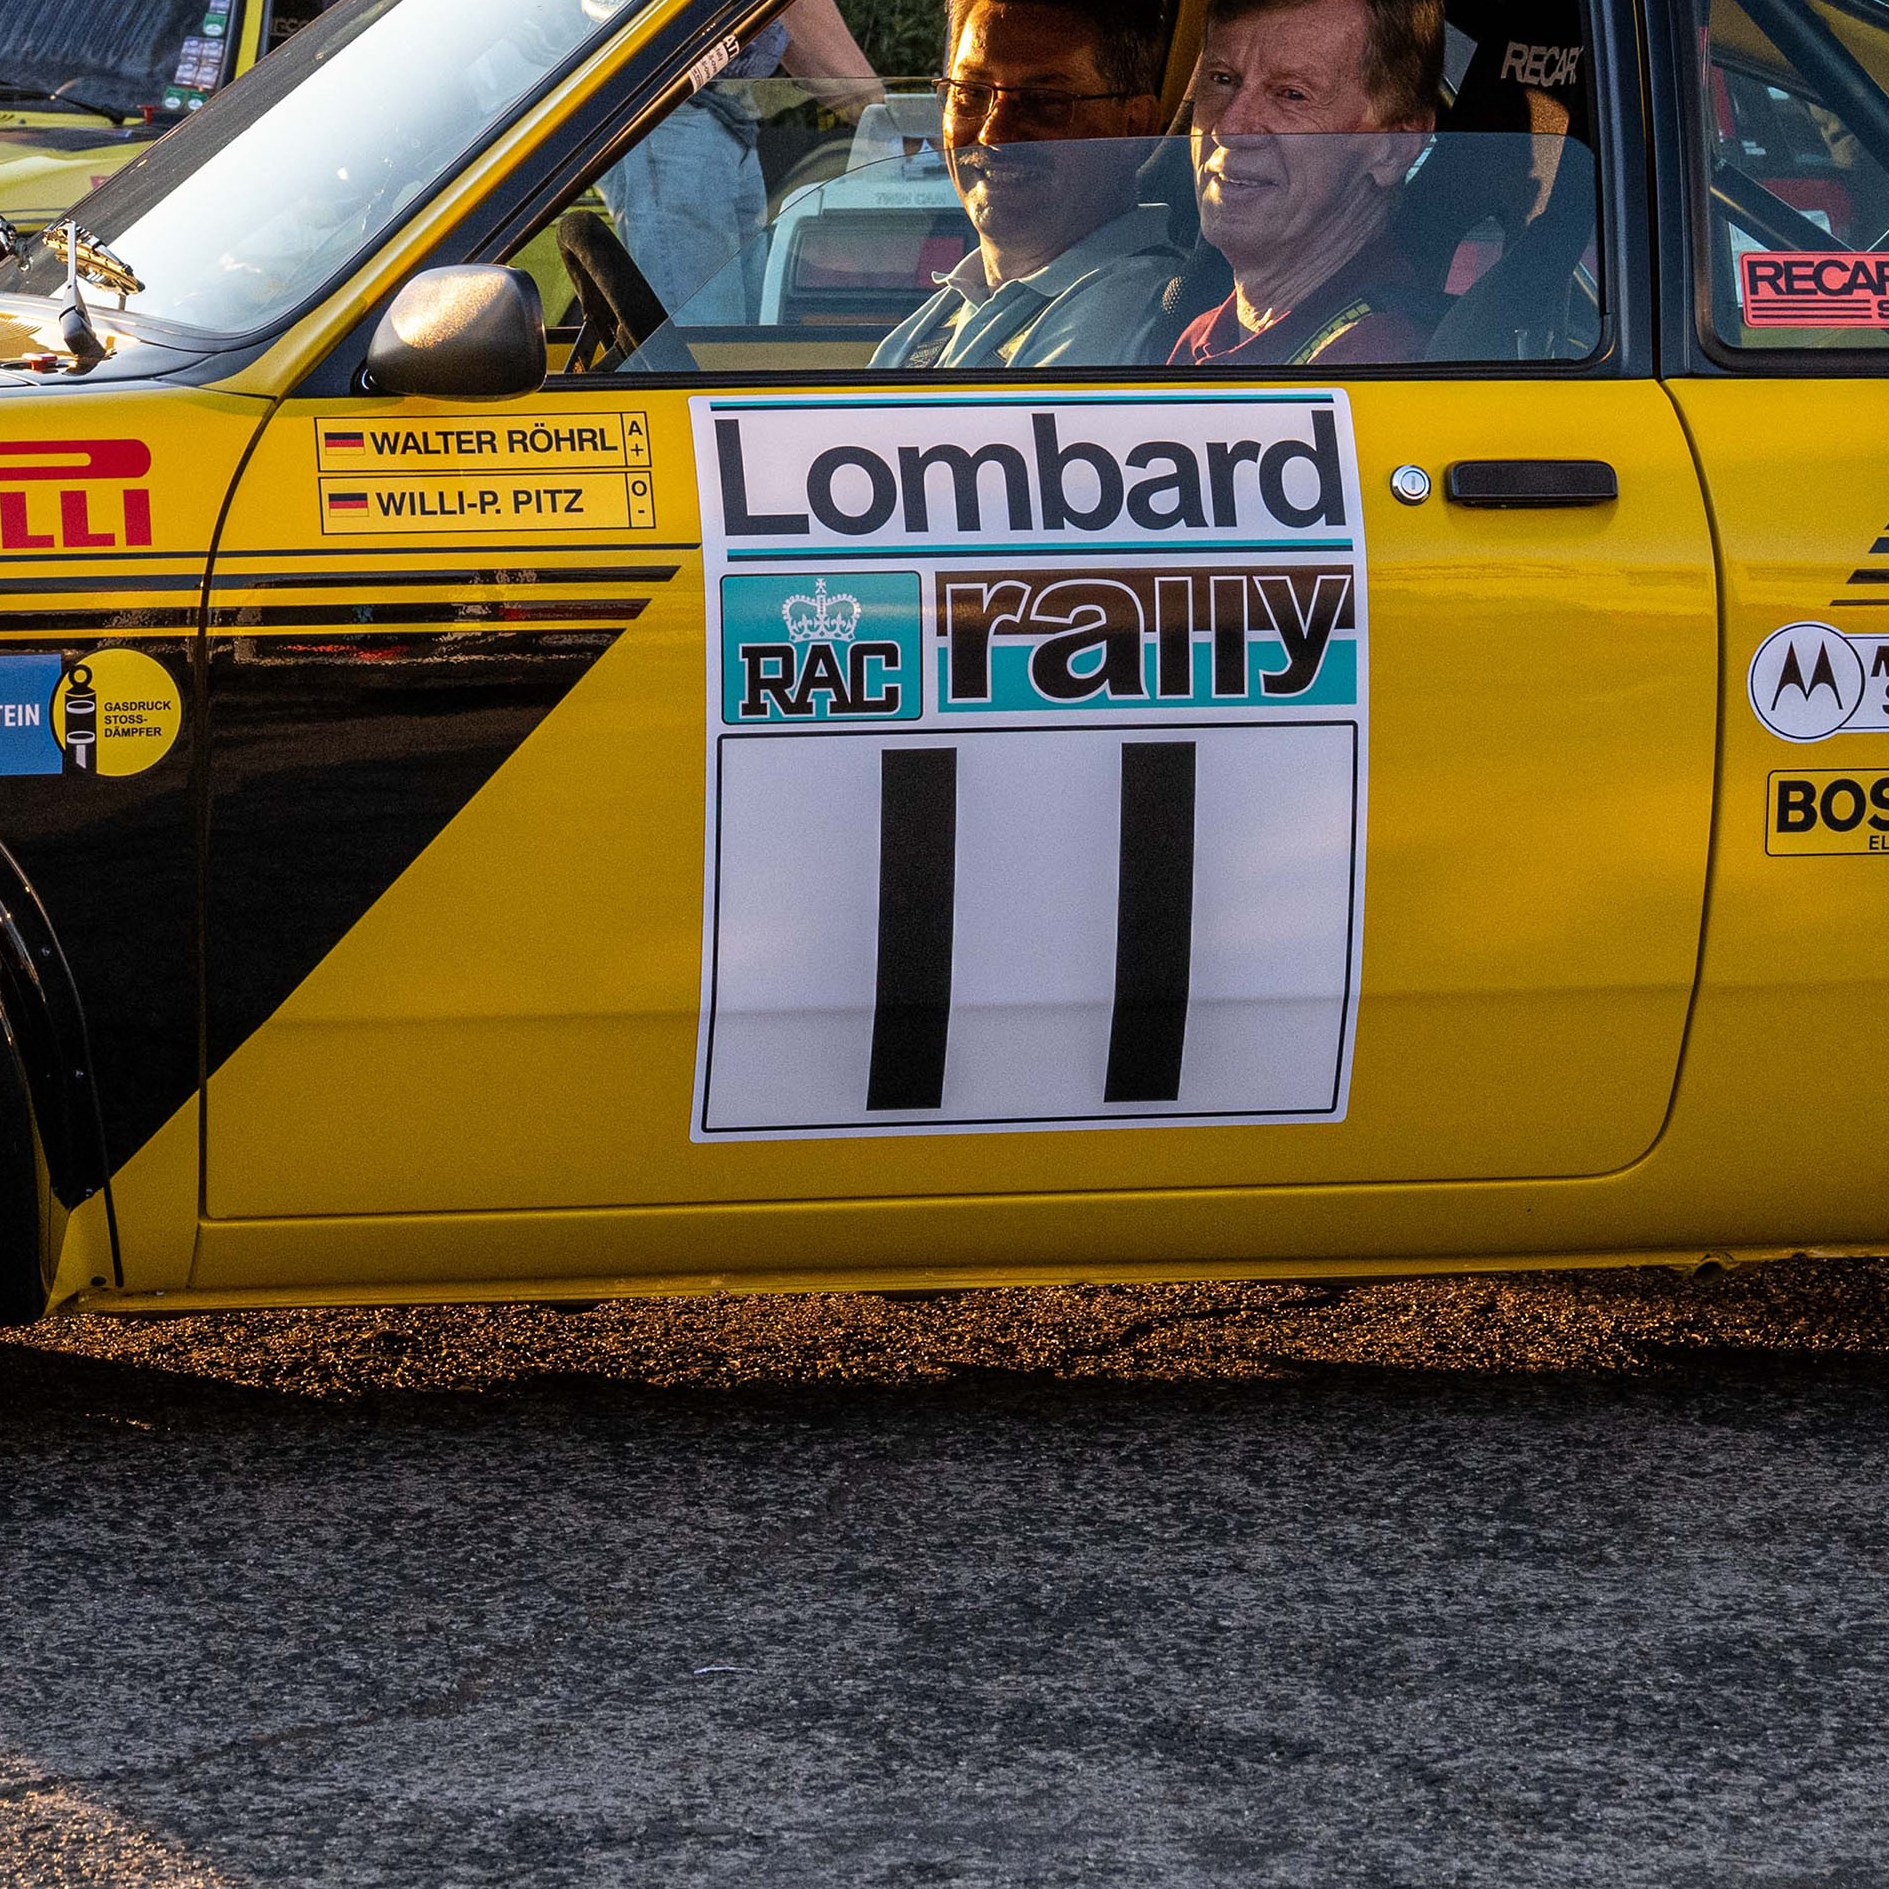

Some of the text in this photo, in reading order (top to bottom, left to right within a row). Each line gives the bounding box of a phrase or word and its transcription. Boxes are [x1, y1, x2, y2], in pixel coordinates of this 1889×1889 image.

[1500, 40, 1585, 88] RECAR
[370, 420, 644, 456] WALTER RÖHRL A
[714, 409, 1347, 537] Lombard
[376, 490, 501, 517] WILLI-P.
[513, 488, 585, 514] PITZ
[944, 573, 1352, 704] rally
[737, 640, 903, 717] RAC
[103, 700, 172, 712] GASDRUCK
[103, 714, 149, 725] STOSS-
[103, 725, 162, 738] DÄMPFER
[865, 740, 1198, 1111] 11
